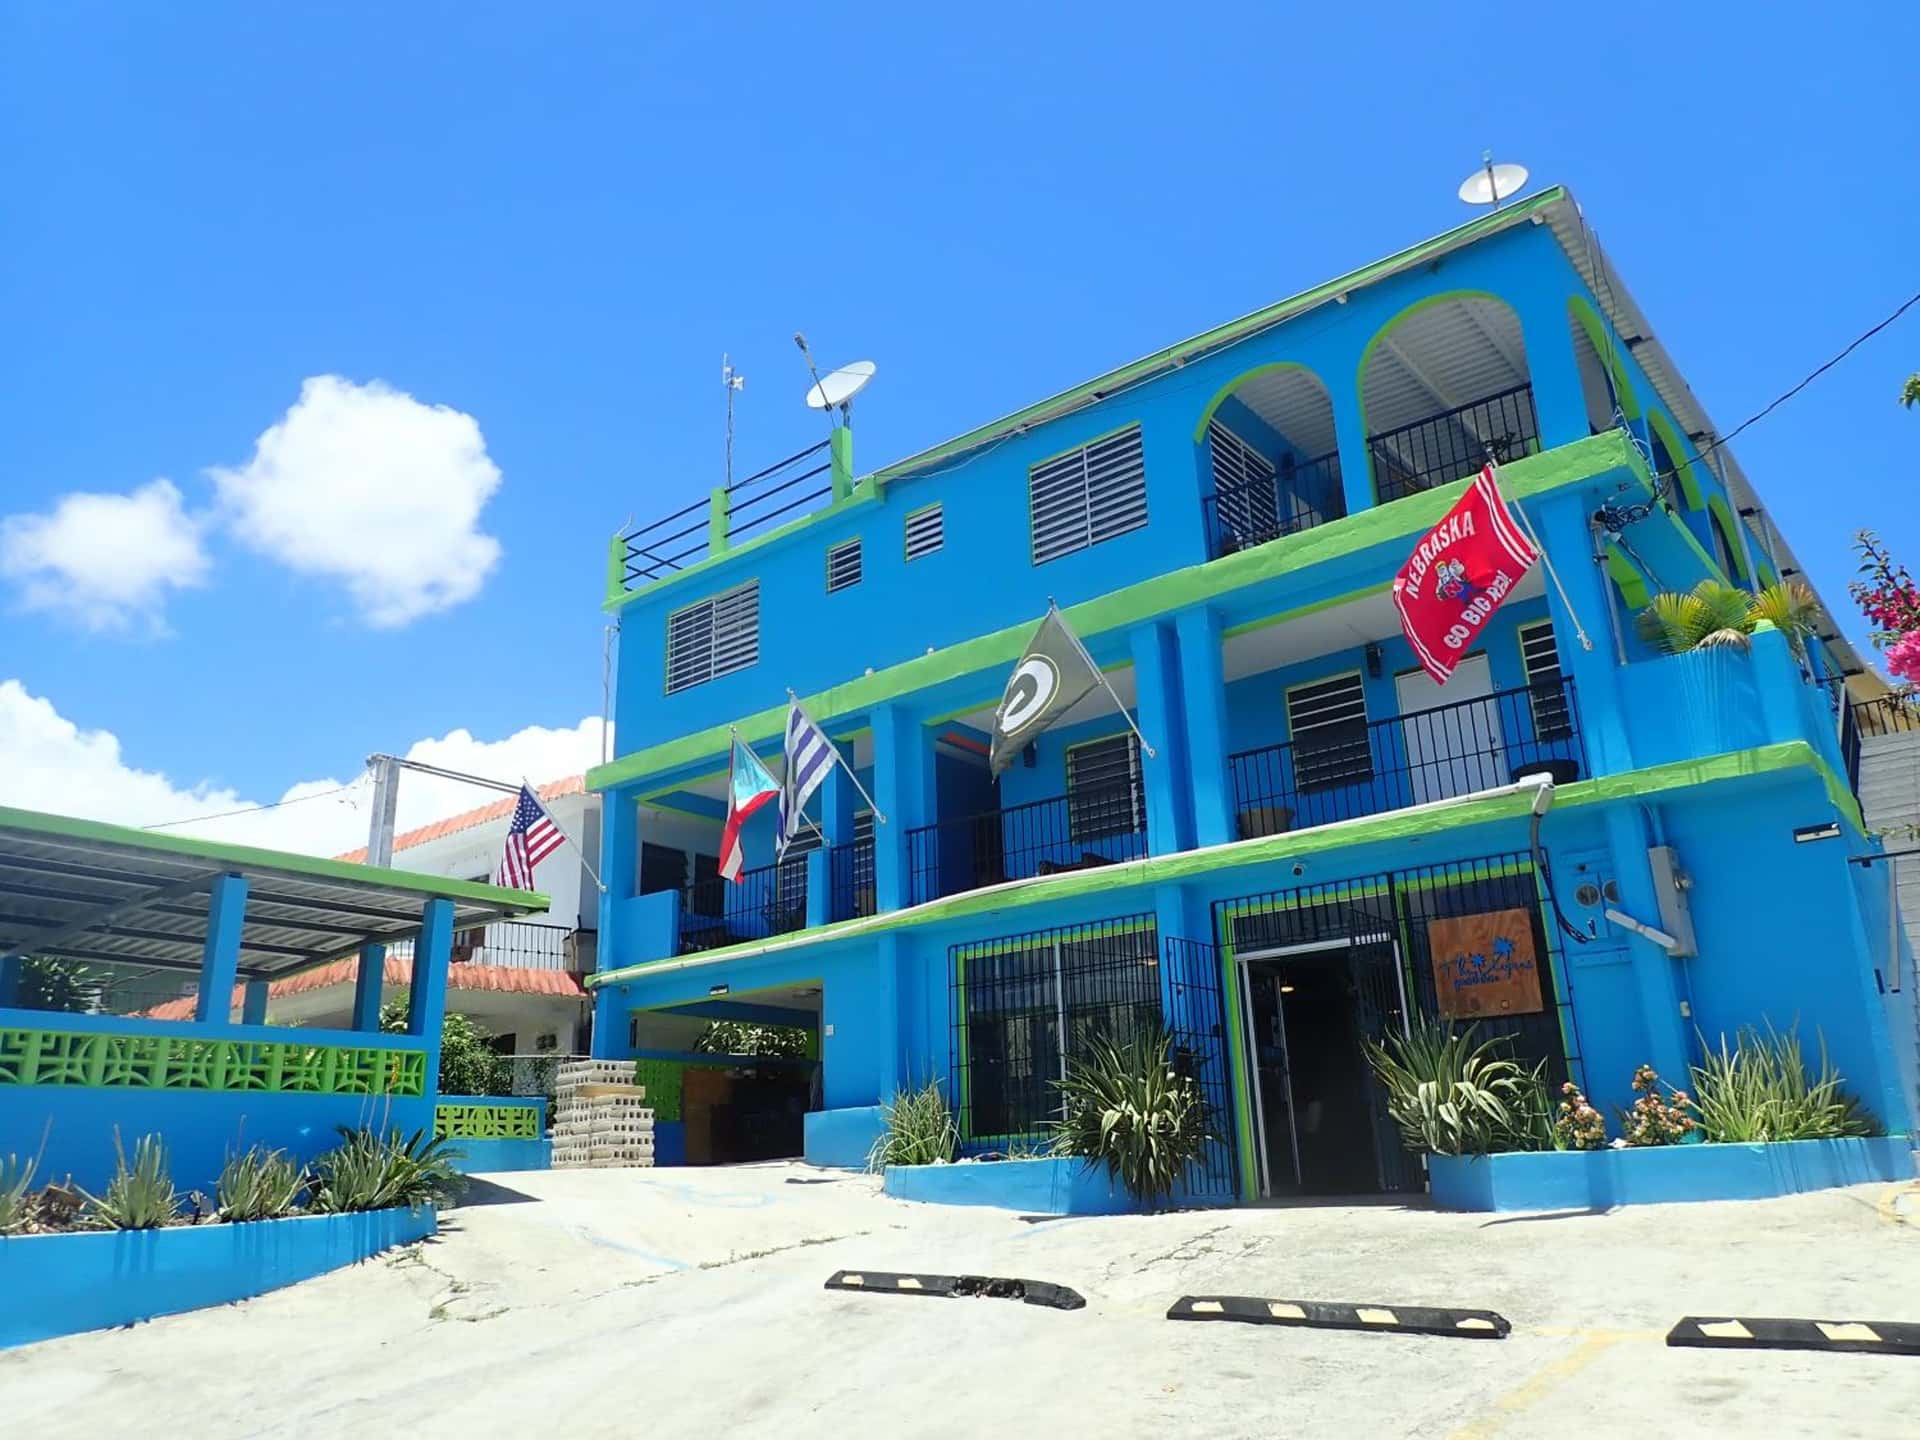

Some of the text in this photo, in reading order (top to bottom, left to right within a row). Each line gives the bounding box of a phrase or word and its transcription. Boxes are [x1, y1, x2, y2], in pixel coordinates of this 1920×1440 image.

[1405, 511, 1475, 599] NEBRASKA
[1443, 624, 1470, 648] GO
[1461, 596, 1493, 625] BIG
